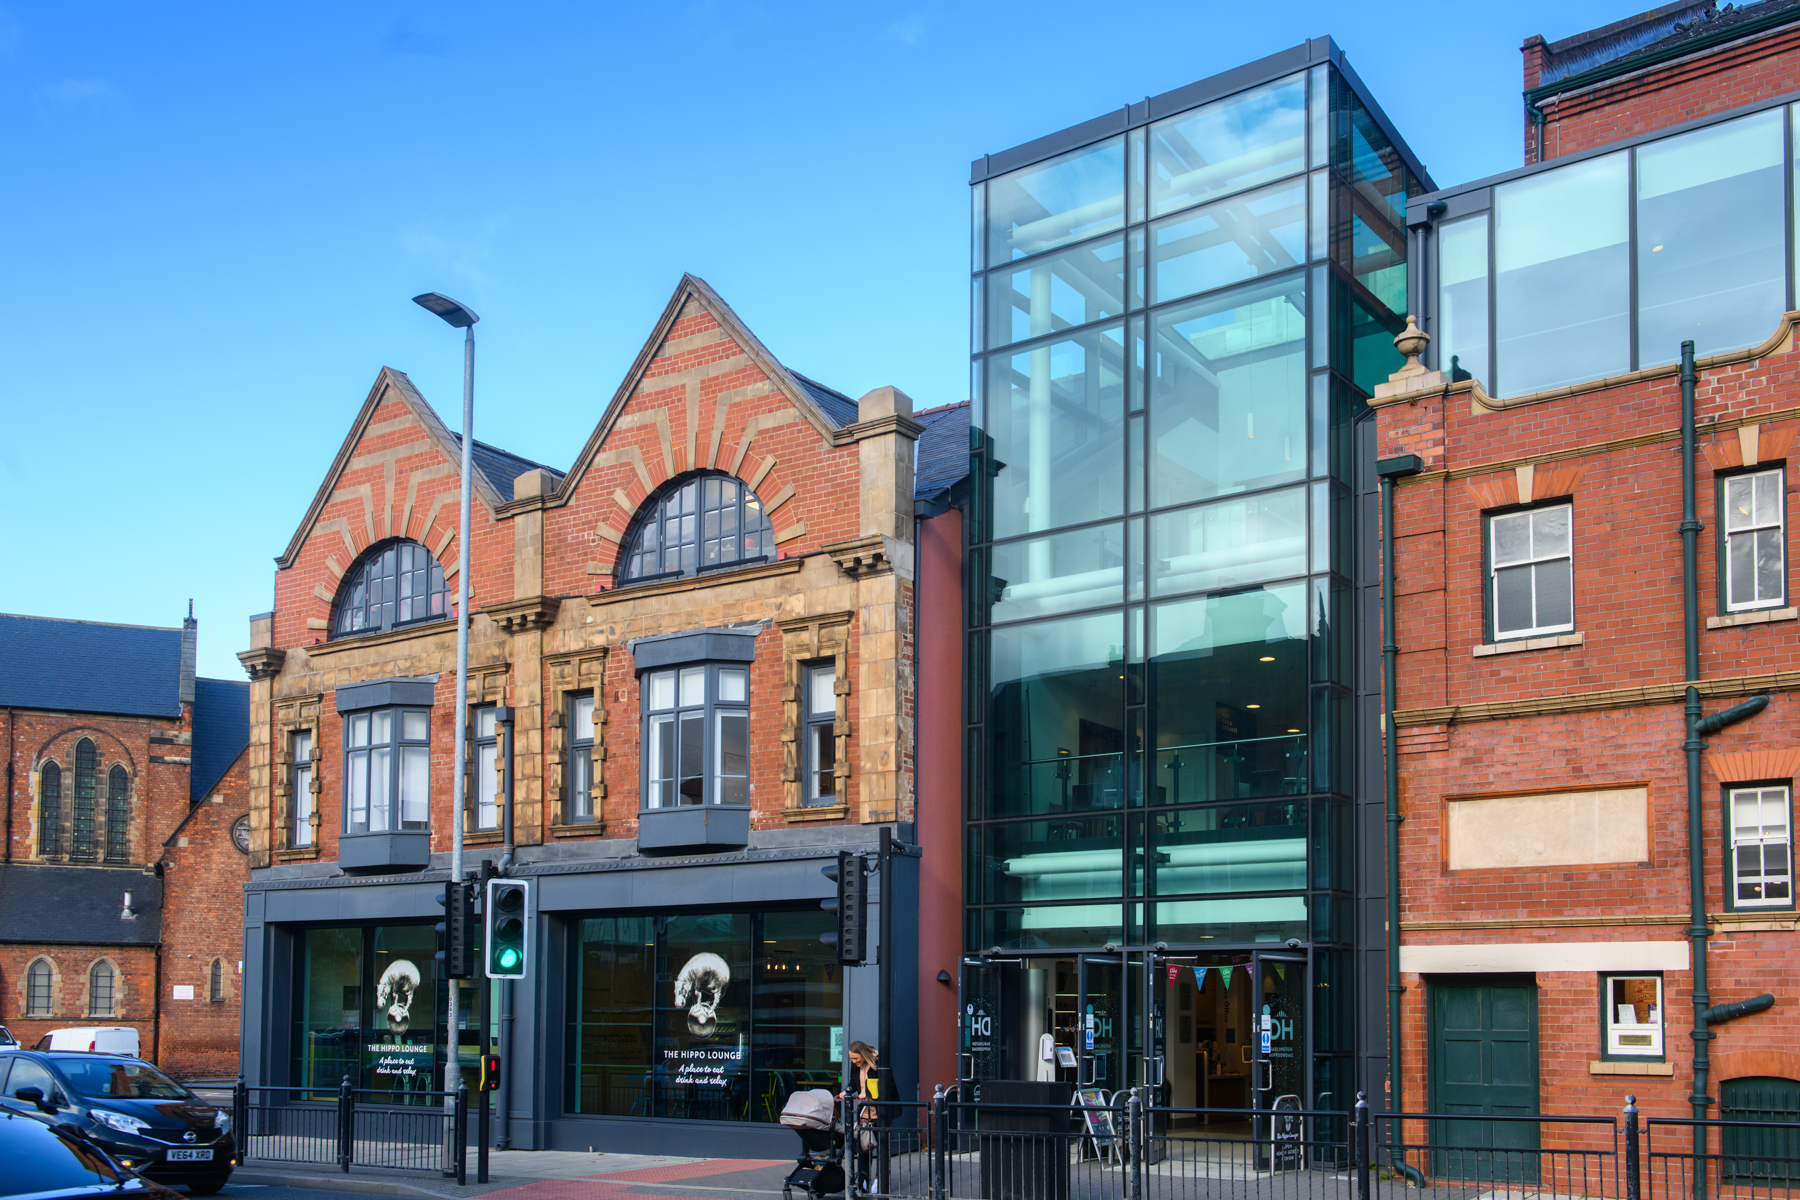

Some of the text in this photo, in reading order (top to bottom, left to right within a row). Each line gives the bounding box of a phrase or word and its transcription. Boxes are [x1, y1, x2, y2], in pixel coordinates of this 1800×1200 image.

[1270, 1019, 1294, 1040] DH
[368, 1044, 380, 1052] THE
[401, 1045, 427, 1053] LOUNGE
[664, 1050, 741, 1060] THE HIPPO LOUNGE
[379, 1056, 415, 1066] A place to eat
[376, 1066, 417, 1077] drink and relax
[678, 1063, 725, 1075] A place to eat
[675, 1075, 727, 1087] drink and relax
[171, 1150, 194, 1160] VE64
